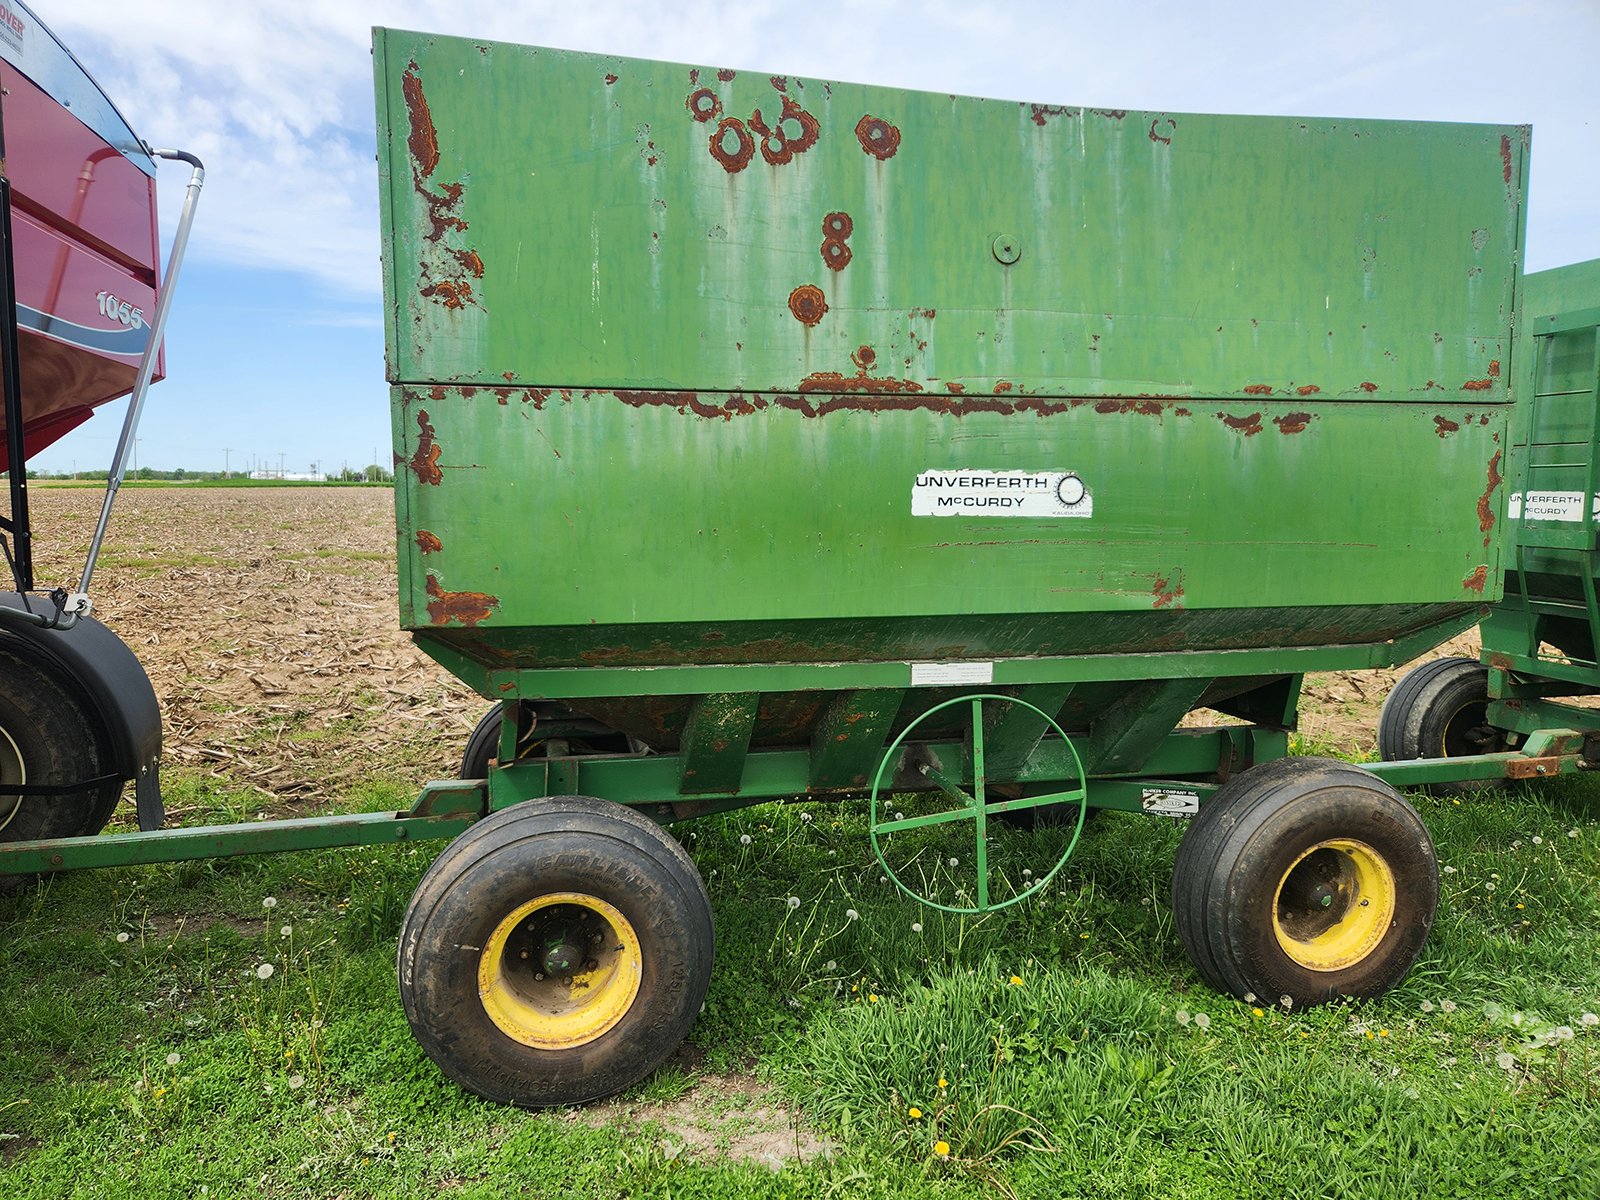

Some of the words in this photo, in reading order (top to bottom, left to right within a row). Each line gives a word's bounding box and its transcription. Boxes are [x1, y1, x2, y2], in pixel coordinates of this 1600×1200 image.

[96, 291, 144, 330] 1055
[916, 476, 1048, 488] UNVERFERTH
[1509, 495, 1582, 504] UNVERFERTH
